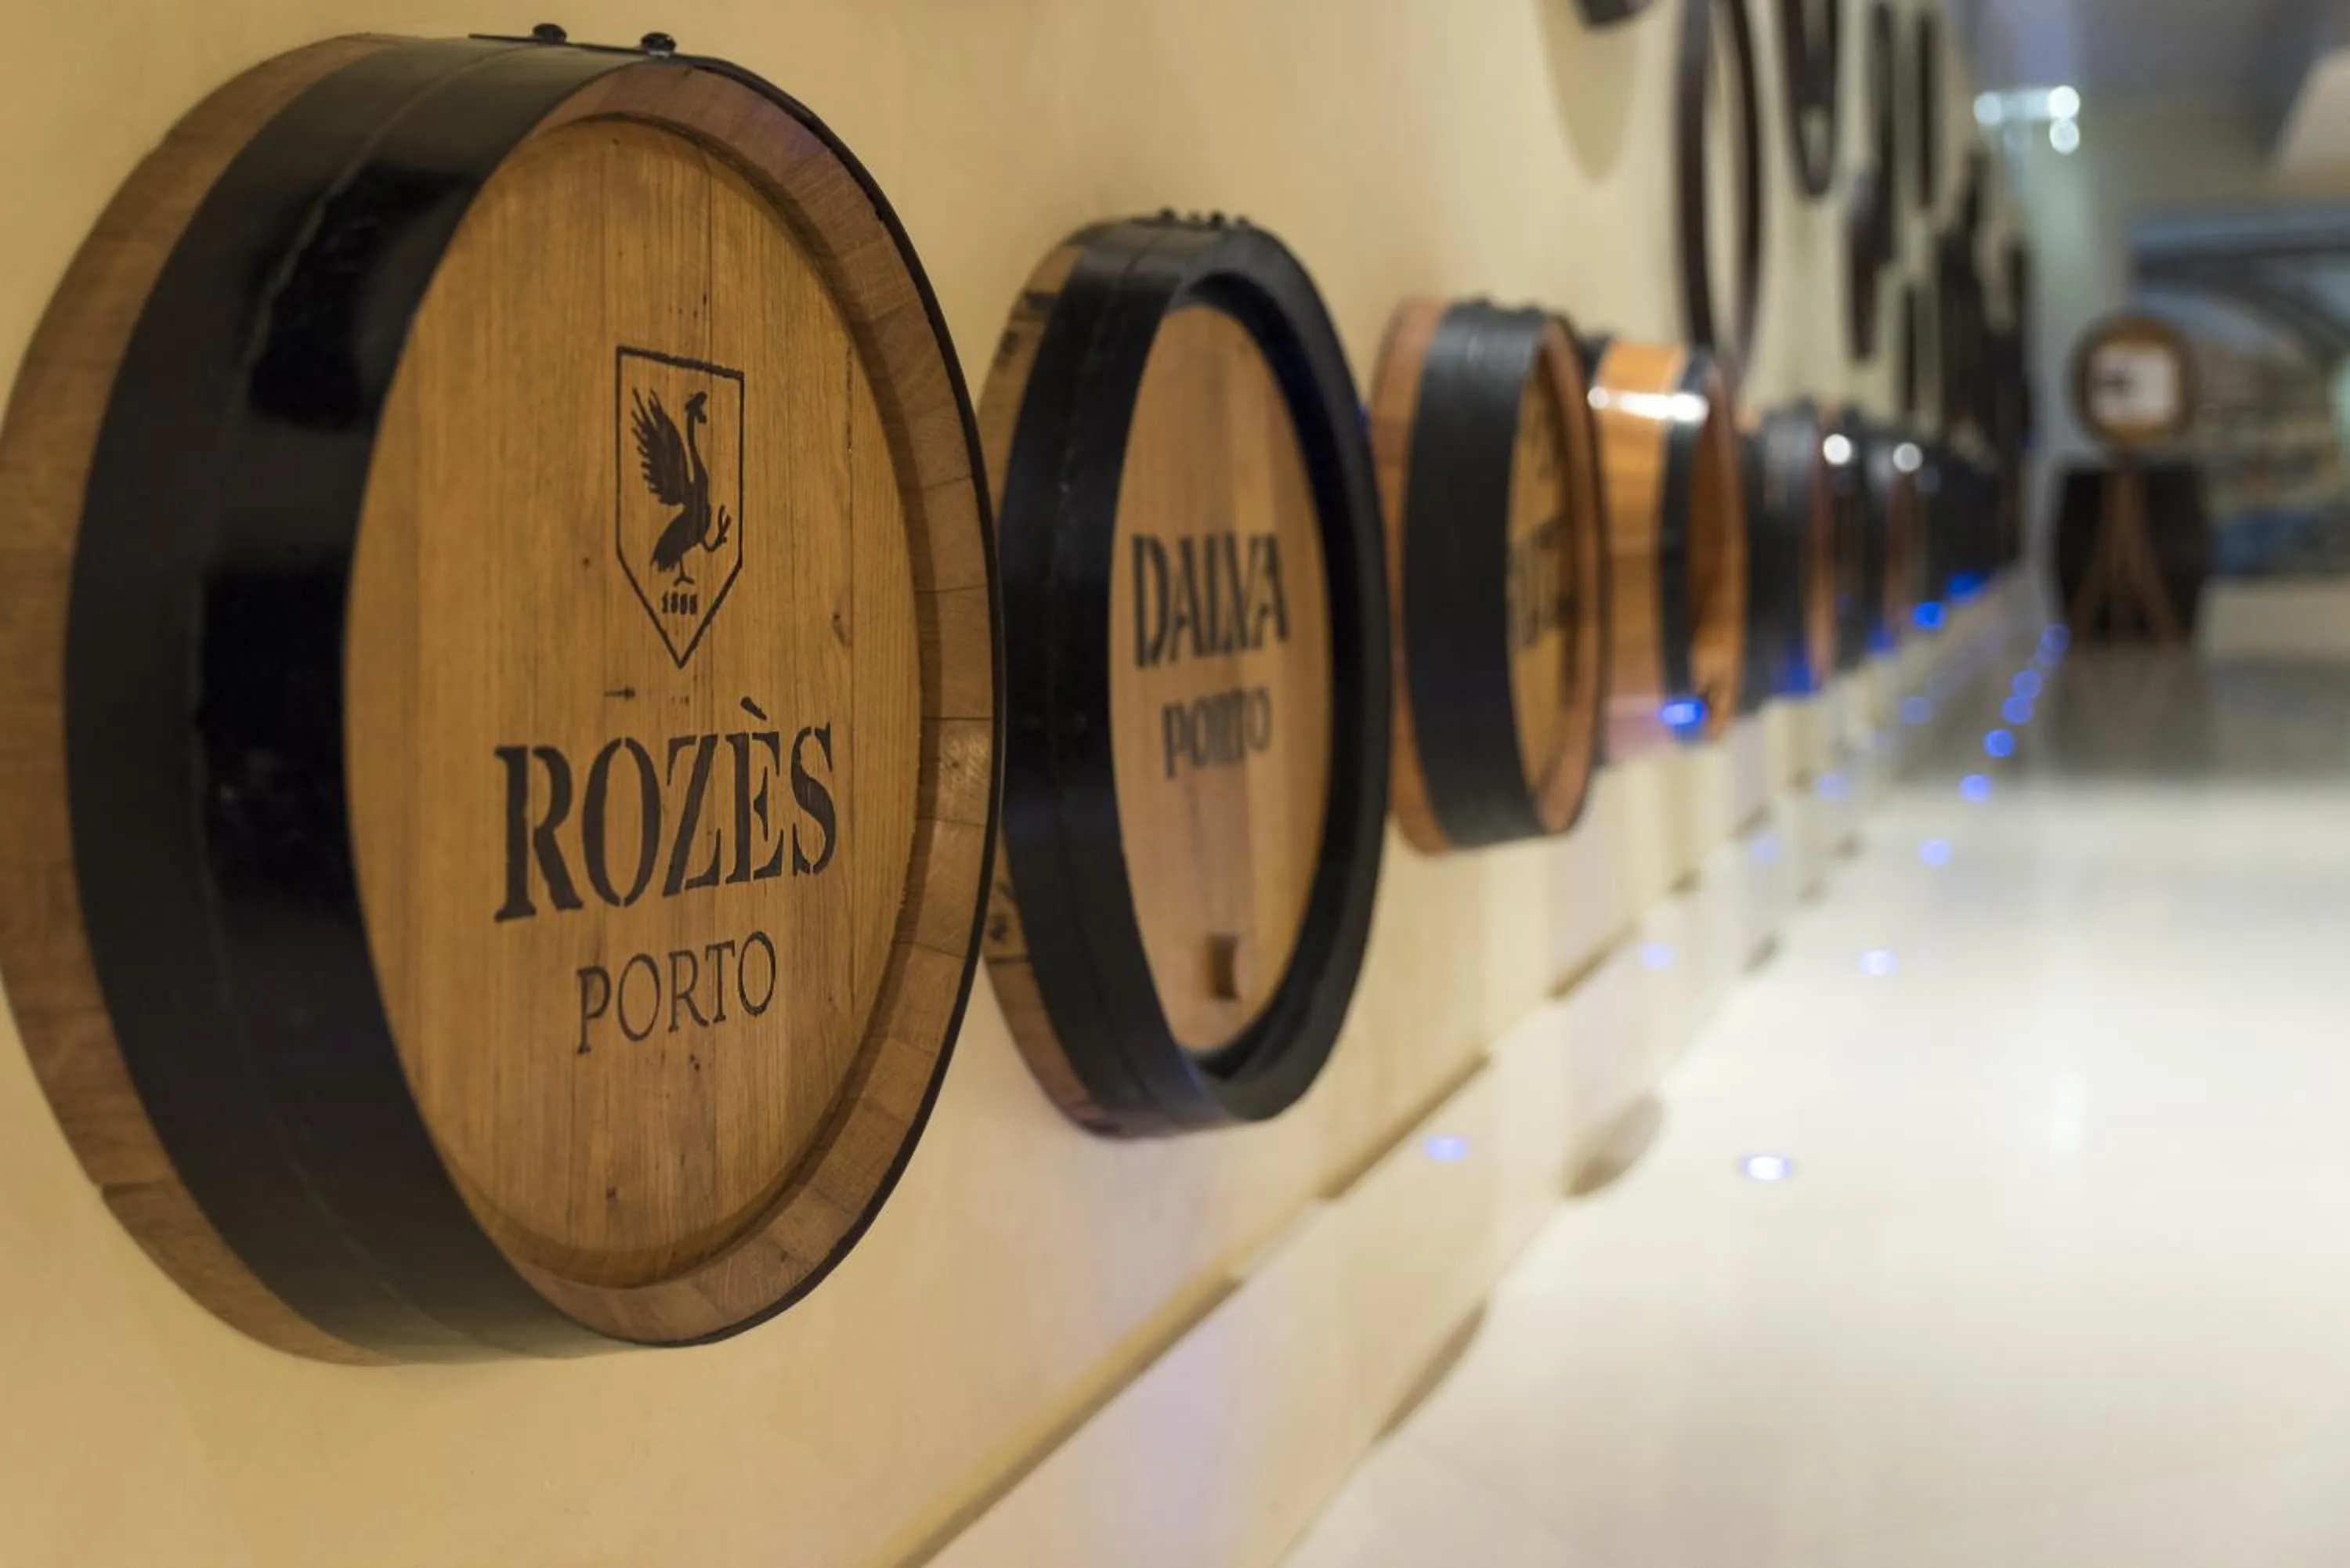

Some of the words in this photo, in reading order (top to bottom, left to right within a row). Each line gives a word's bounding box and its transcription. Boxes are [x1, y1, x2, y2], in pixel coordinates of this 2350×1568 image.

[1132, 533, 1289, 669] DALVA
[494, 697, 837, 923] ROZÈS
[577, 931, 776, 1054] PORTO
